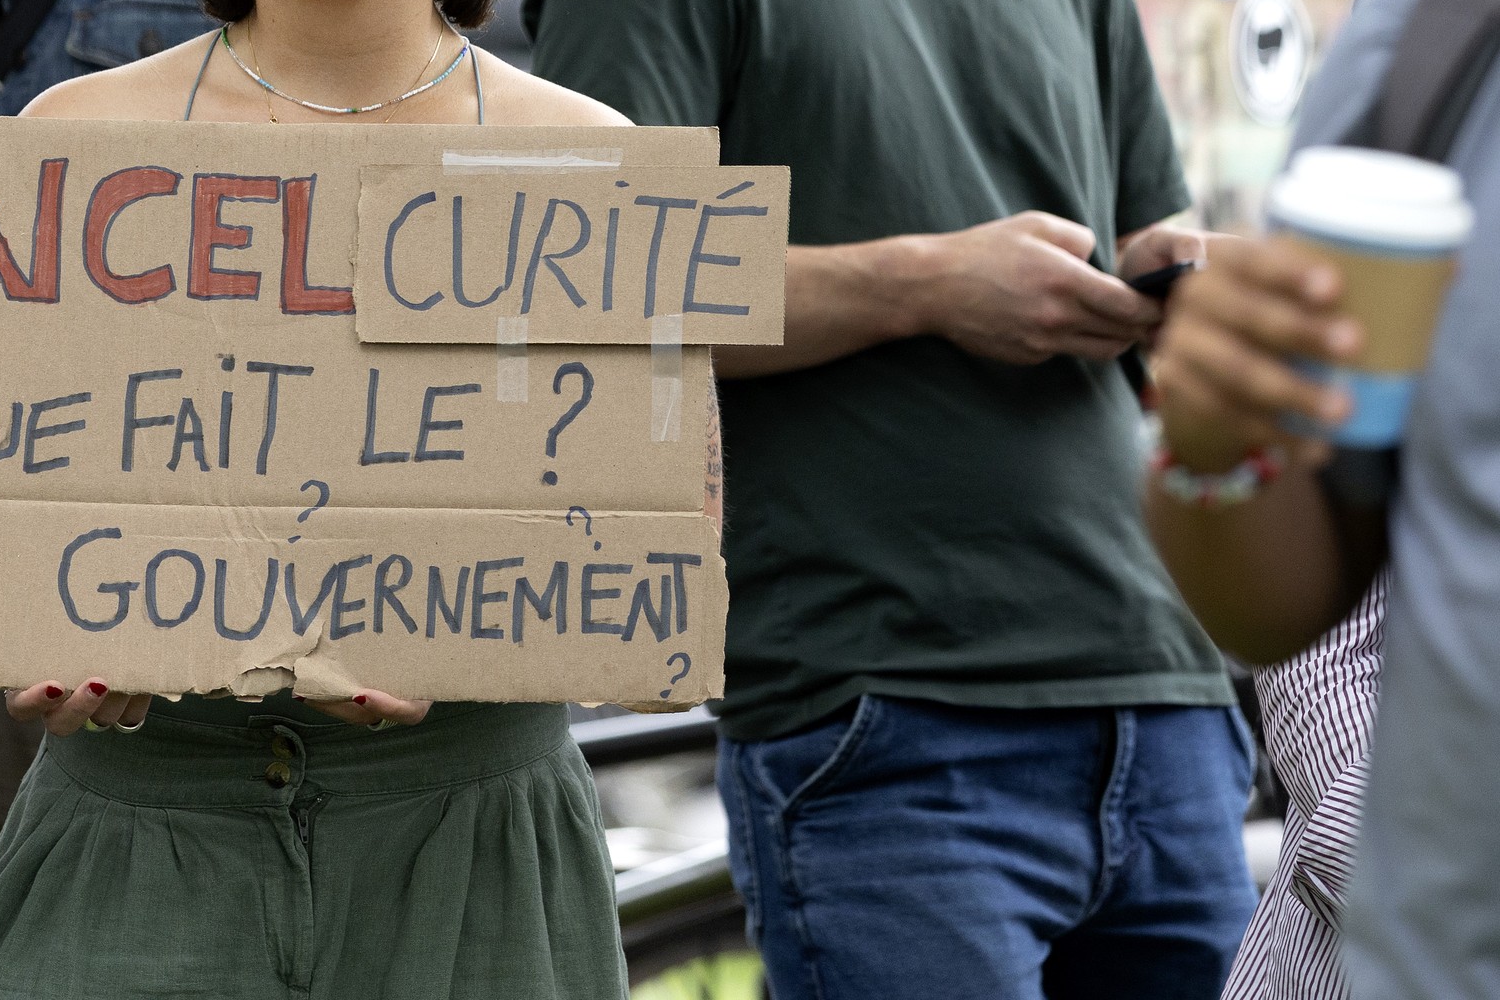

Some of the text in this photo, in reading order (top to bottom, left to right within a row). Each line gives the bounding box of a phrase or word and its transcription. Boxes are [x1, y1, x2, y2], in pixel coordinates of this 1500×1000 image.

[359, 371, 482, 466] LE
[540, 361, 595, 486] ?
[288, 479, 331, 543] ?
[58, 526, 702, 643] GOUVERNEMENT
[658, 651, 693, 699] ?
